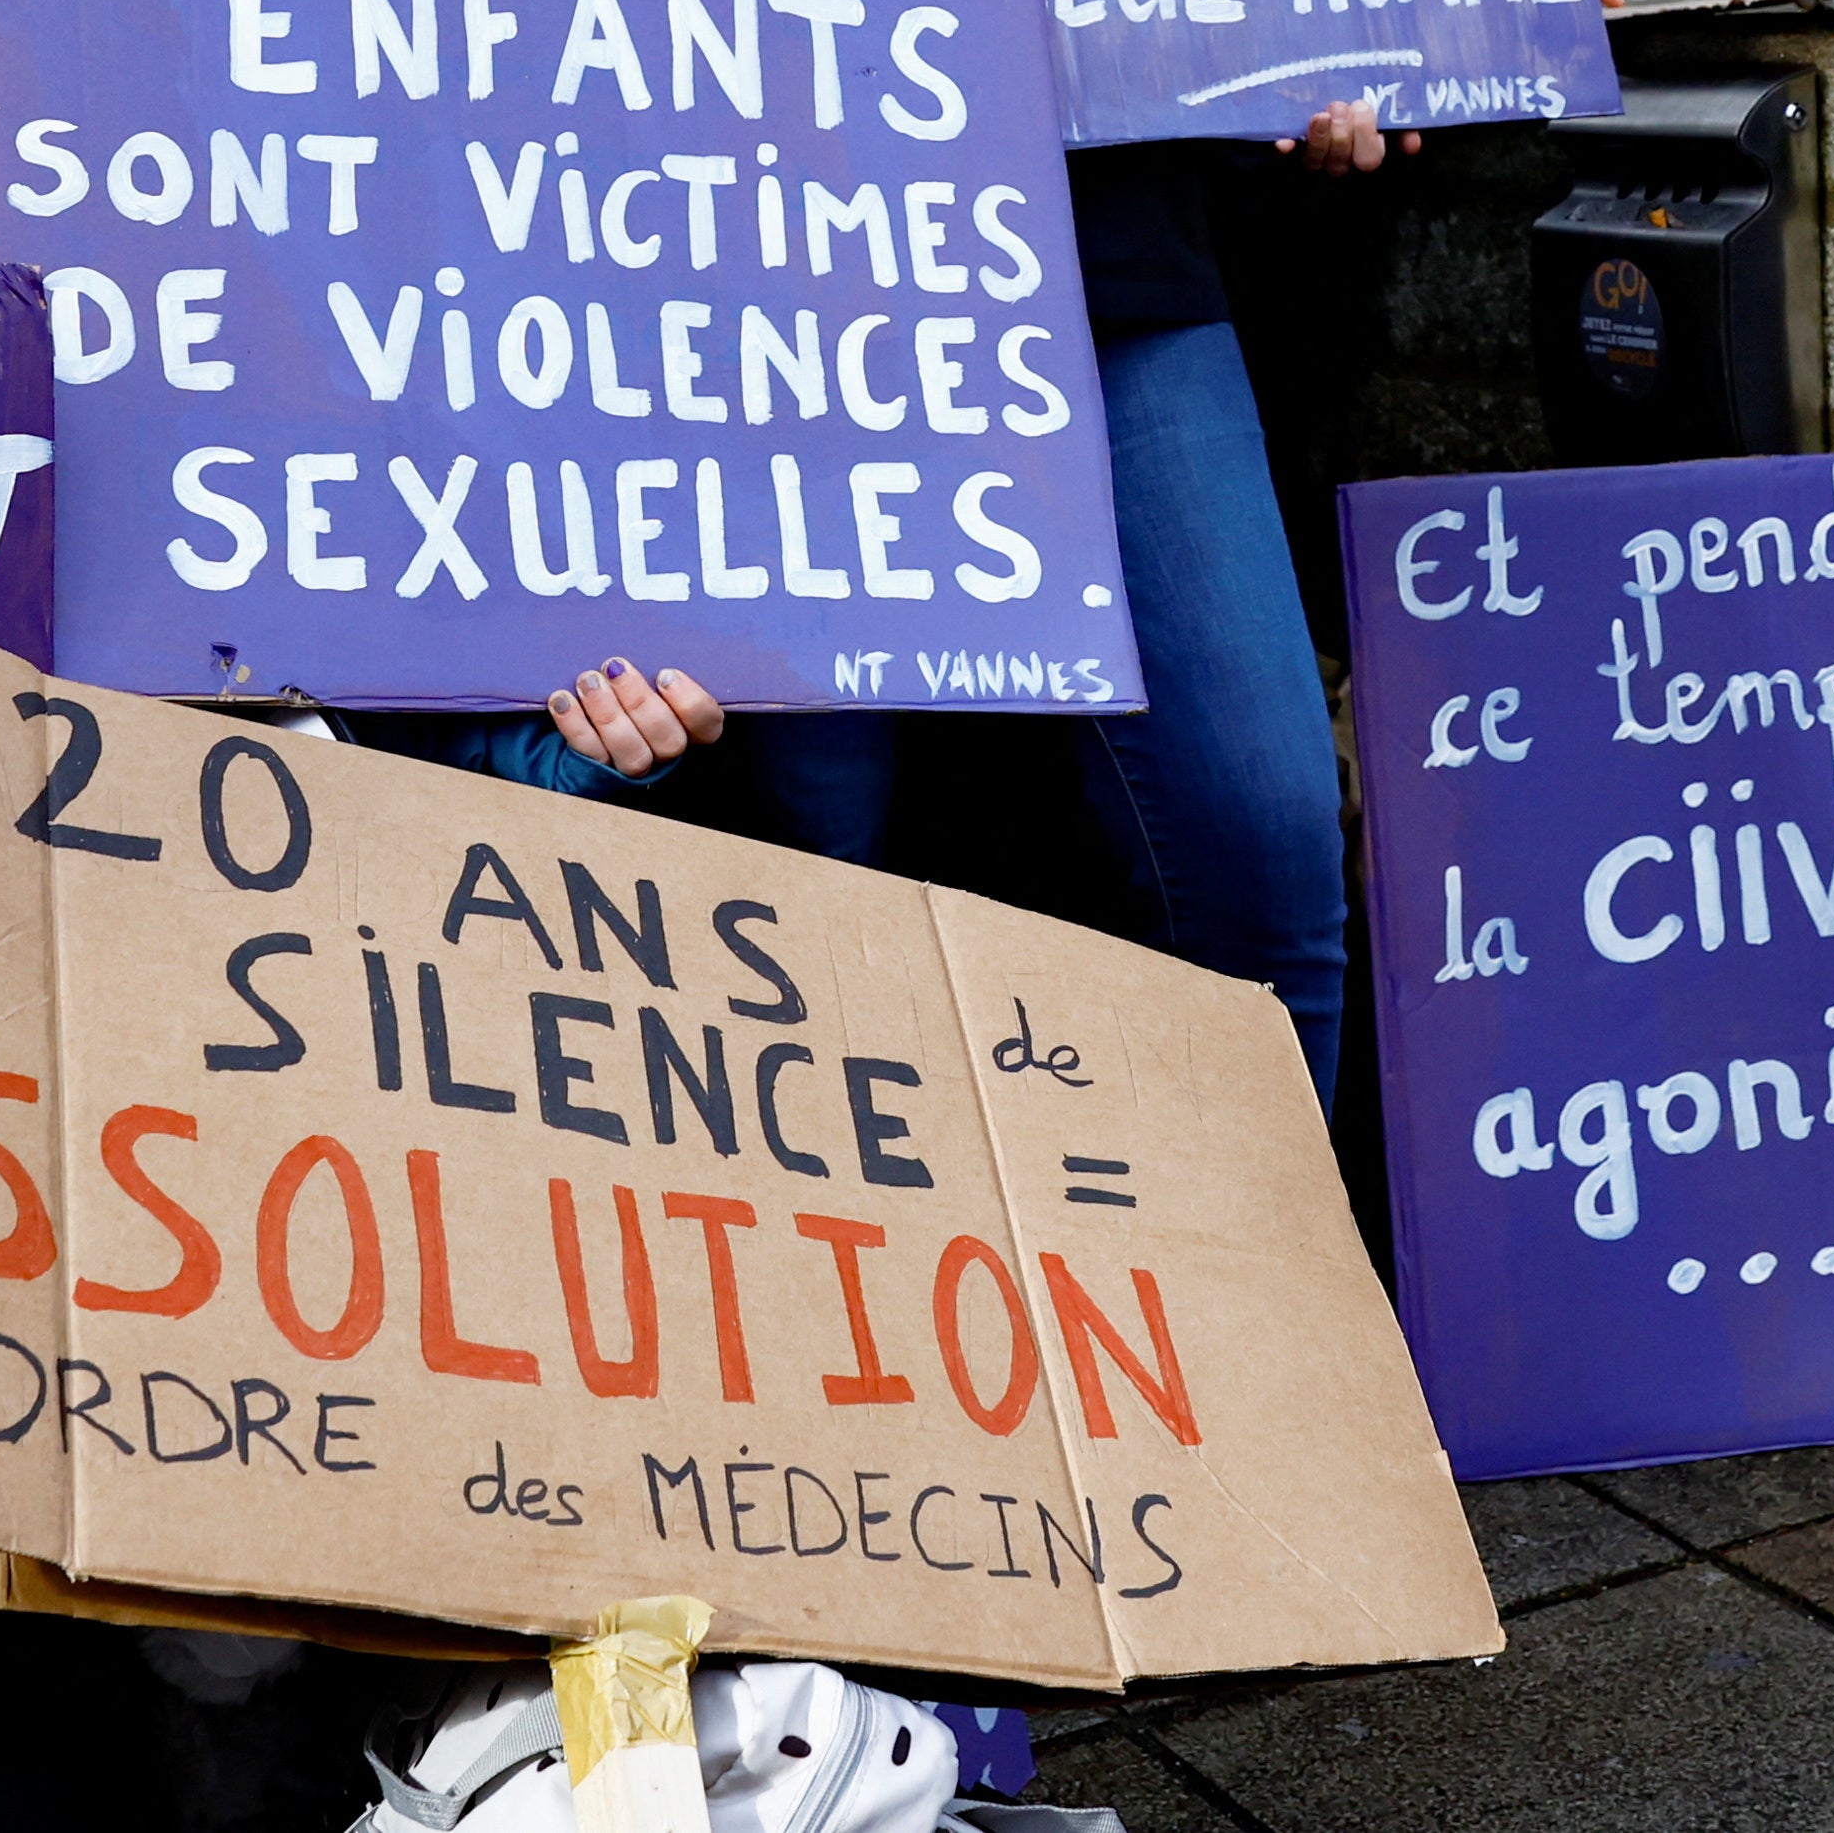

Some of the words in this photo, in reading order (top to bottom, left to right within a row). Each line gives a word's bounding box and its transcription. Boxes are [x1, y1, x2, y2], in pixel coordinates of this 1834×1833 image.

[1426, 74, 1567, 119] VANNES
[7, 117, 378, 238] SONT
[44, 266, 234, 391] DE
[1394, 485, 1544, 621] Et
[835, 651, 891, 697] NT
[917, 651, 1115, 704] VANNES
[1423, 686, 1534, 769] ce
[12, 691, 310, 892] 20
[442, 842, 808, 1026] ANS
[992, 996, 1095, 1088] de
[1435, 866, 1528, 983] la
[203, 925, 935, 1188] SILENCE
[464, 1439, 584, 1528] des
[644, 1444, 1184, 1600] MÉDECINS
